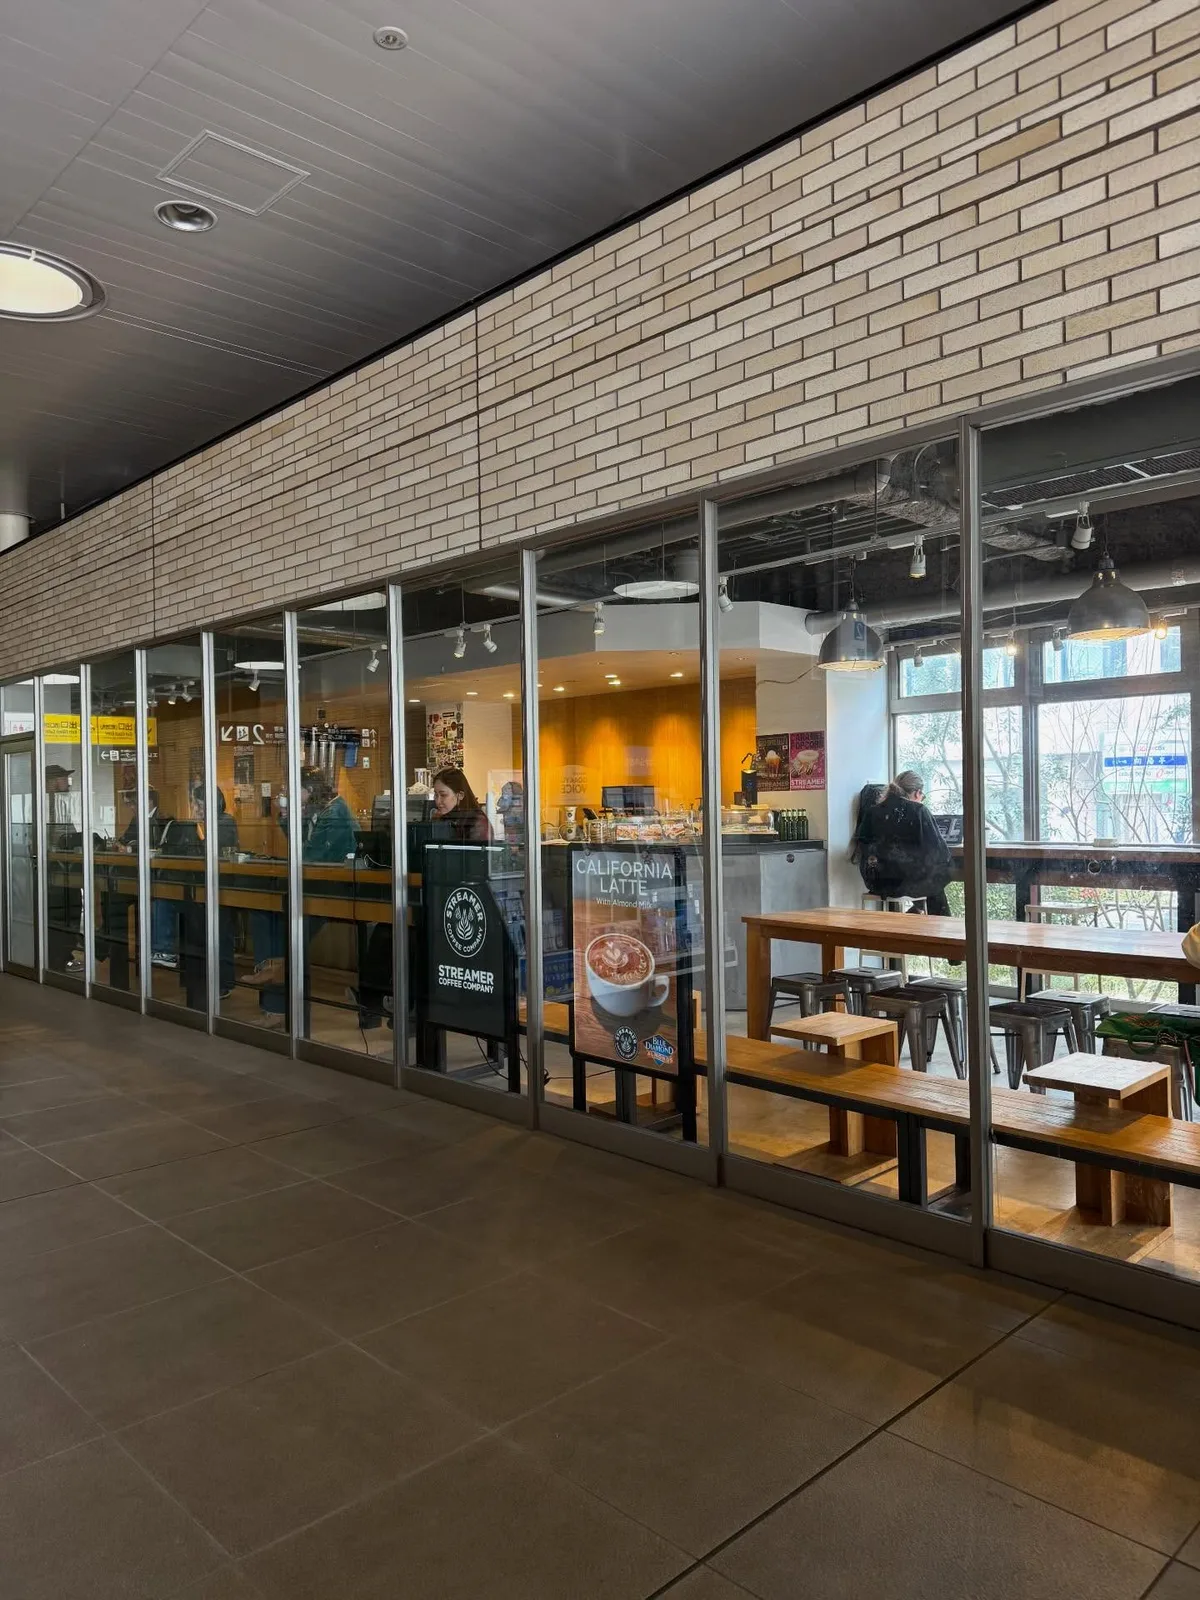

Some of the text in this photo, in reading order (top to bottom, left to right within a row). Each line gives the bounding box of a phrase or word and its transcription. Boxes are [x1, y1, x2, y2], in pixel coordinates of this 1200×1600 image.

[576, 858, 673, 880] CALIFORNIA
[600, 877, 648, 896] LATTE
[446, 891, 484, 921] STREAMER
[596, 897, 611, 906] With
[612, 898, 638, 908] Almond
[447, 923, 484, 953] COFFEE COMPANY
[438, 964, 494, 985] STREAMER
[438, 977, 494, 994] COFFEE COMPANY
